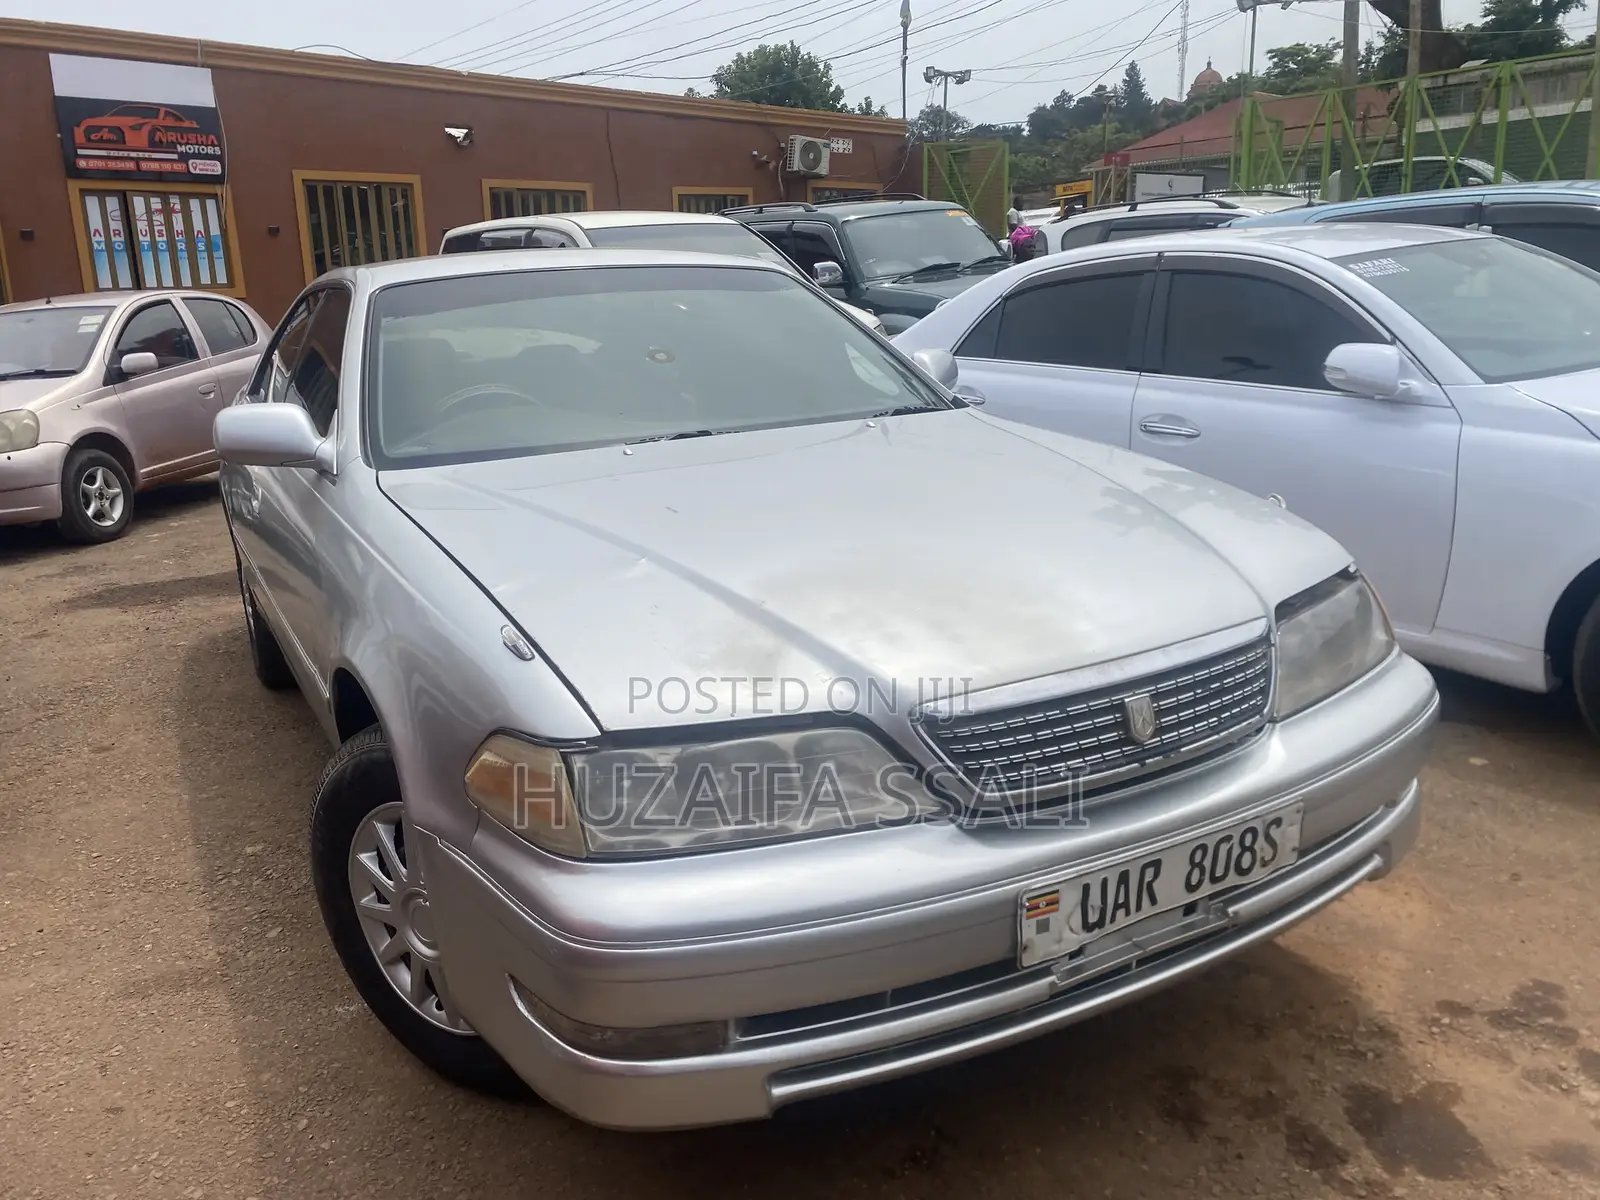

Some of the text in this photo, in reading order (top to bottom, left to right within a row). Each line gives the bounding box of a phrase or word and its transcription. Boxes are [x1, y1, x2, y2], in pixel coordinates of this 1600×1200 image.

[154, 132, 218, 145] ARUSHA
[177, 144, 221, 155] MOTORS
[93, 229, 205, 239] ARUSHA
[94, 241, 206, 251] MOTORS
[1081, 817, 1282, 932] UAR 808S
